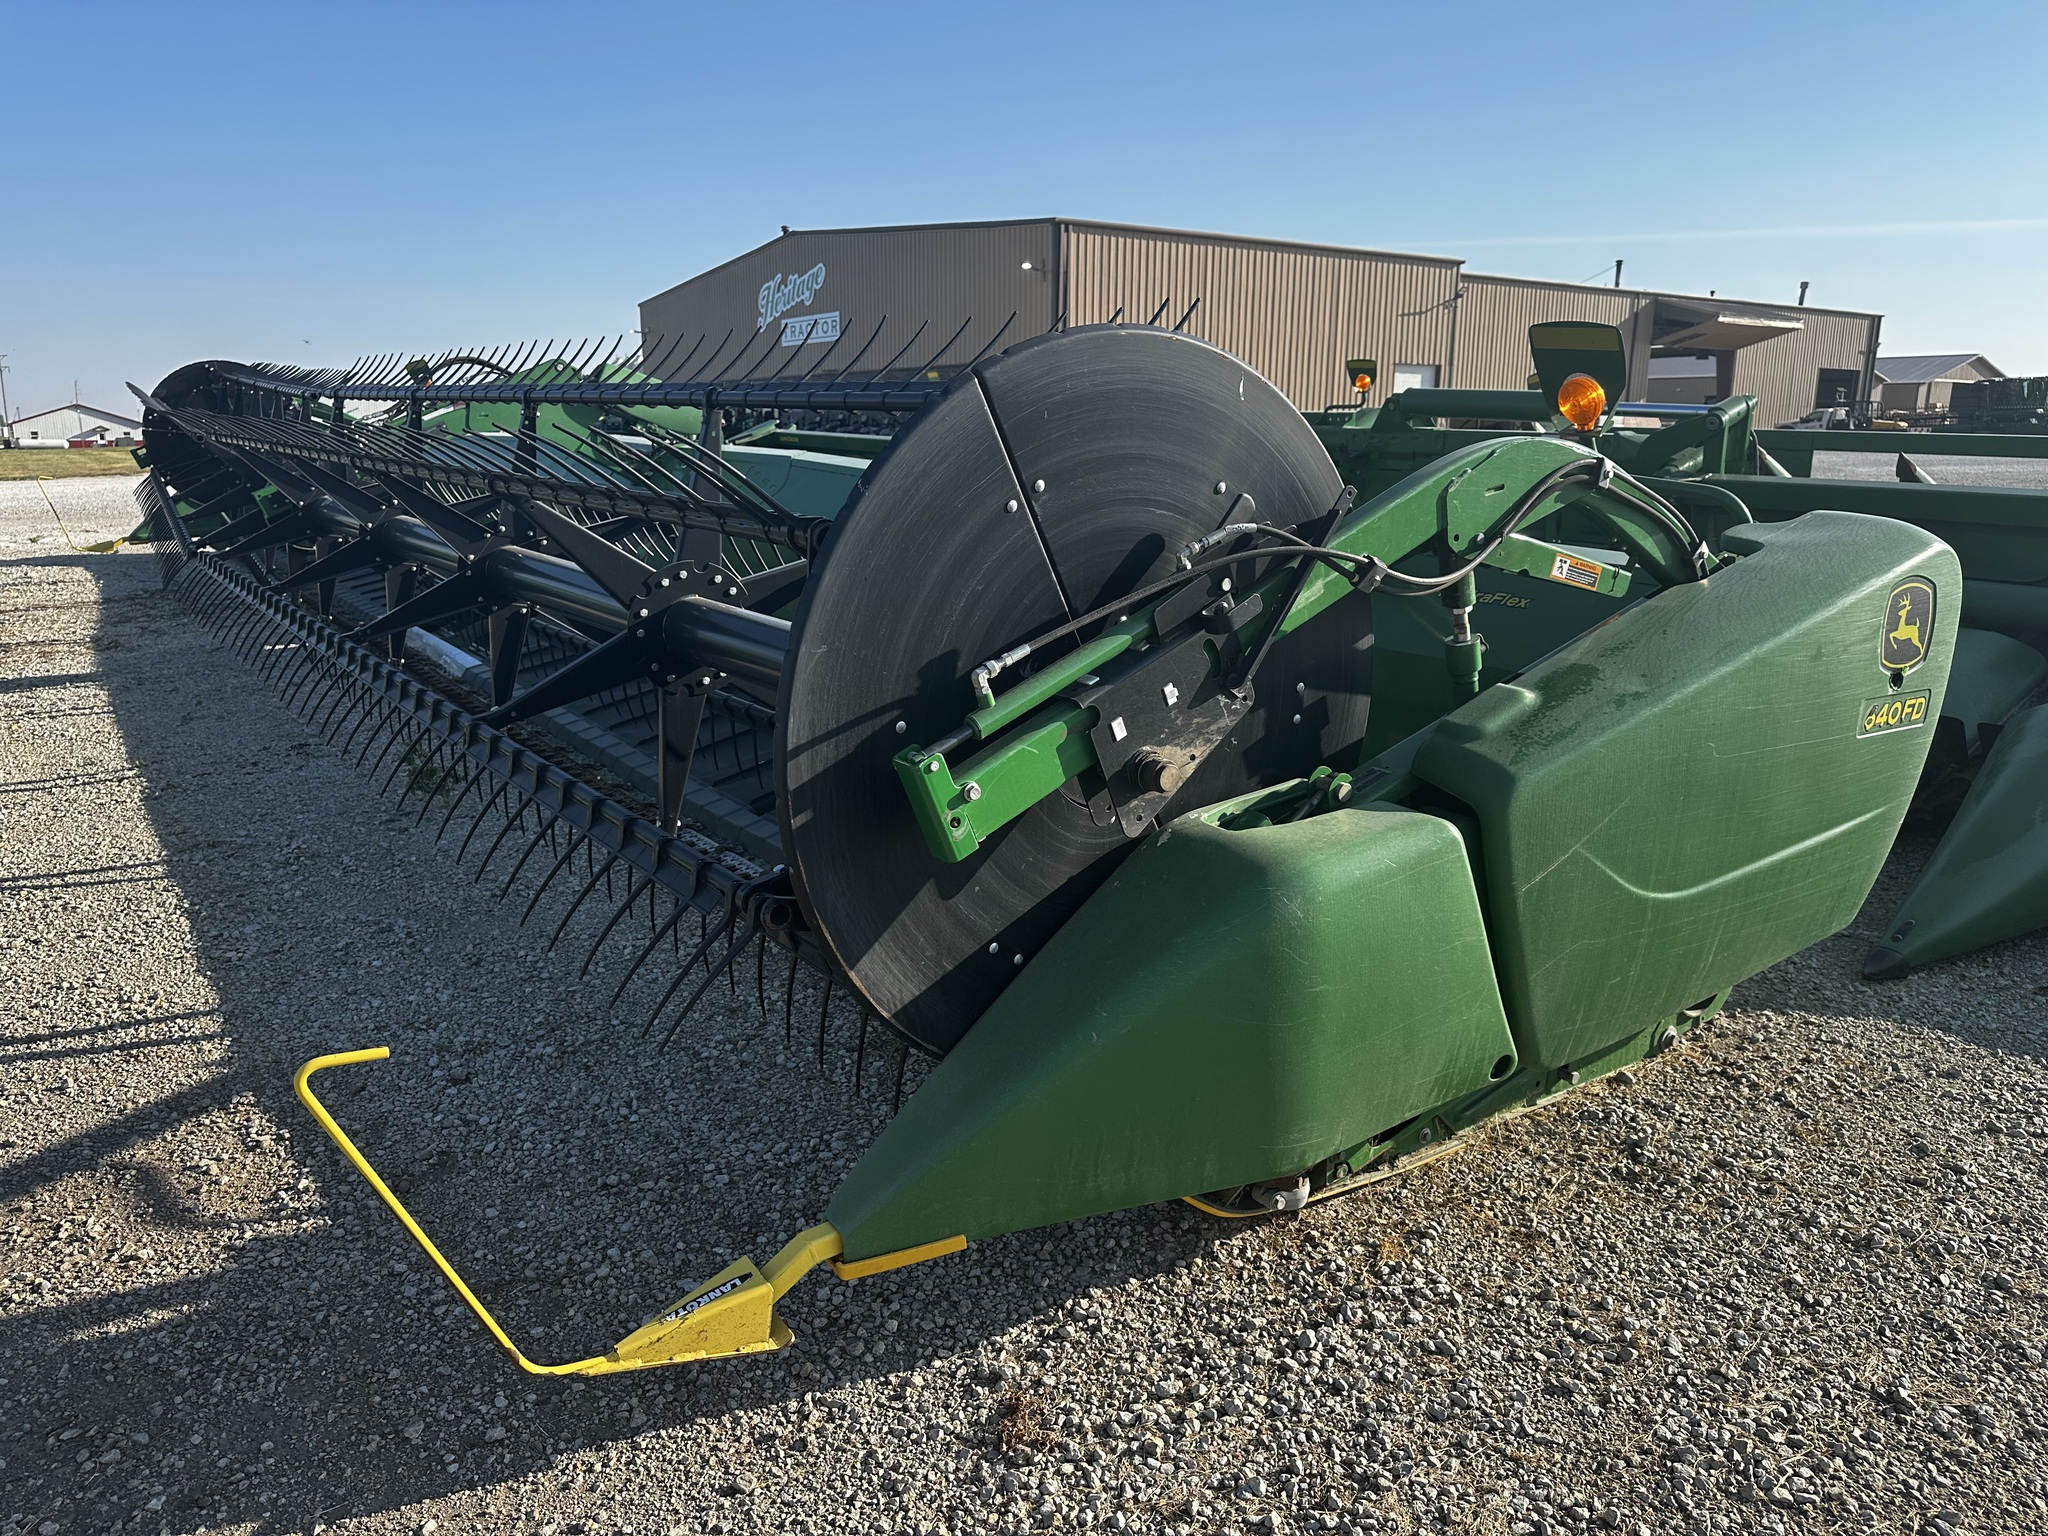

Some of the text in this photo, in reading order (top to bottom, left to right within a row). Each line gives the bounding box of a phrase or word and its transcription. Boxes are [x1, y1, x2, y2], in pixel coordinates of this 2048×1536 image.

[758, 264, 825, 331] Heritage
[1474, 591, 1531, 608] raFlex
[666, 1278, 742, 1322] LANKOTA
